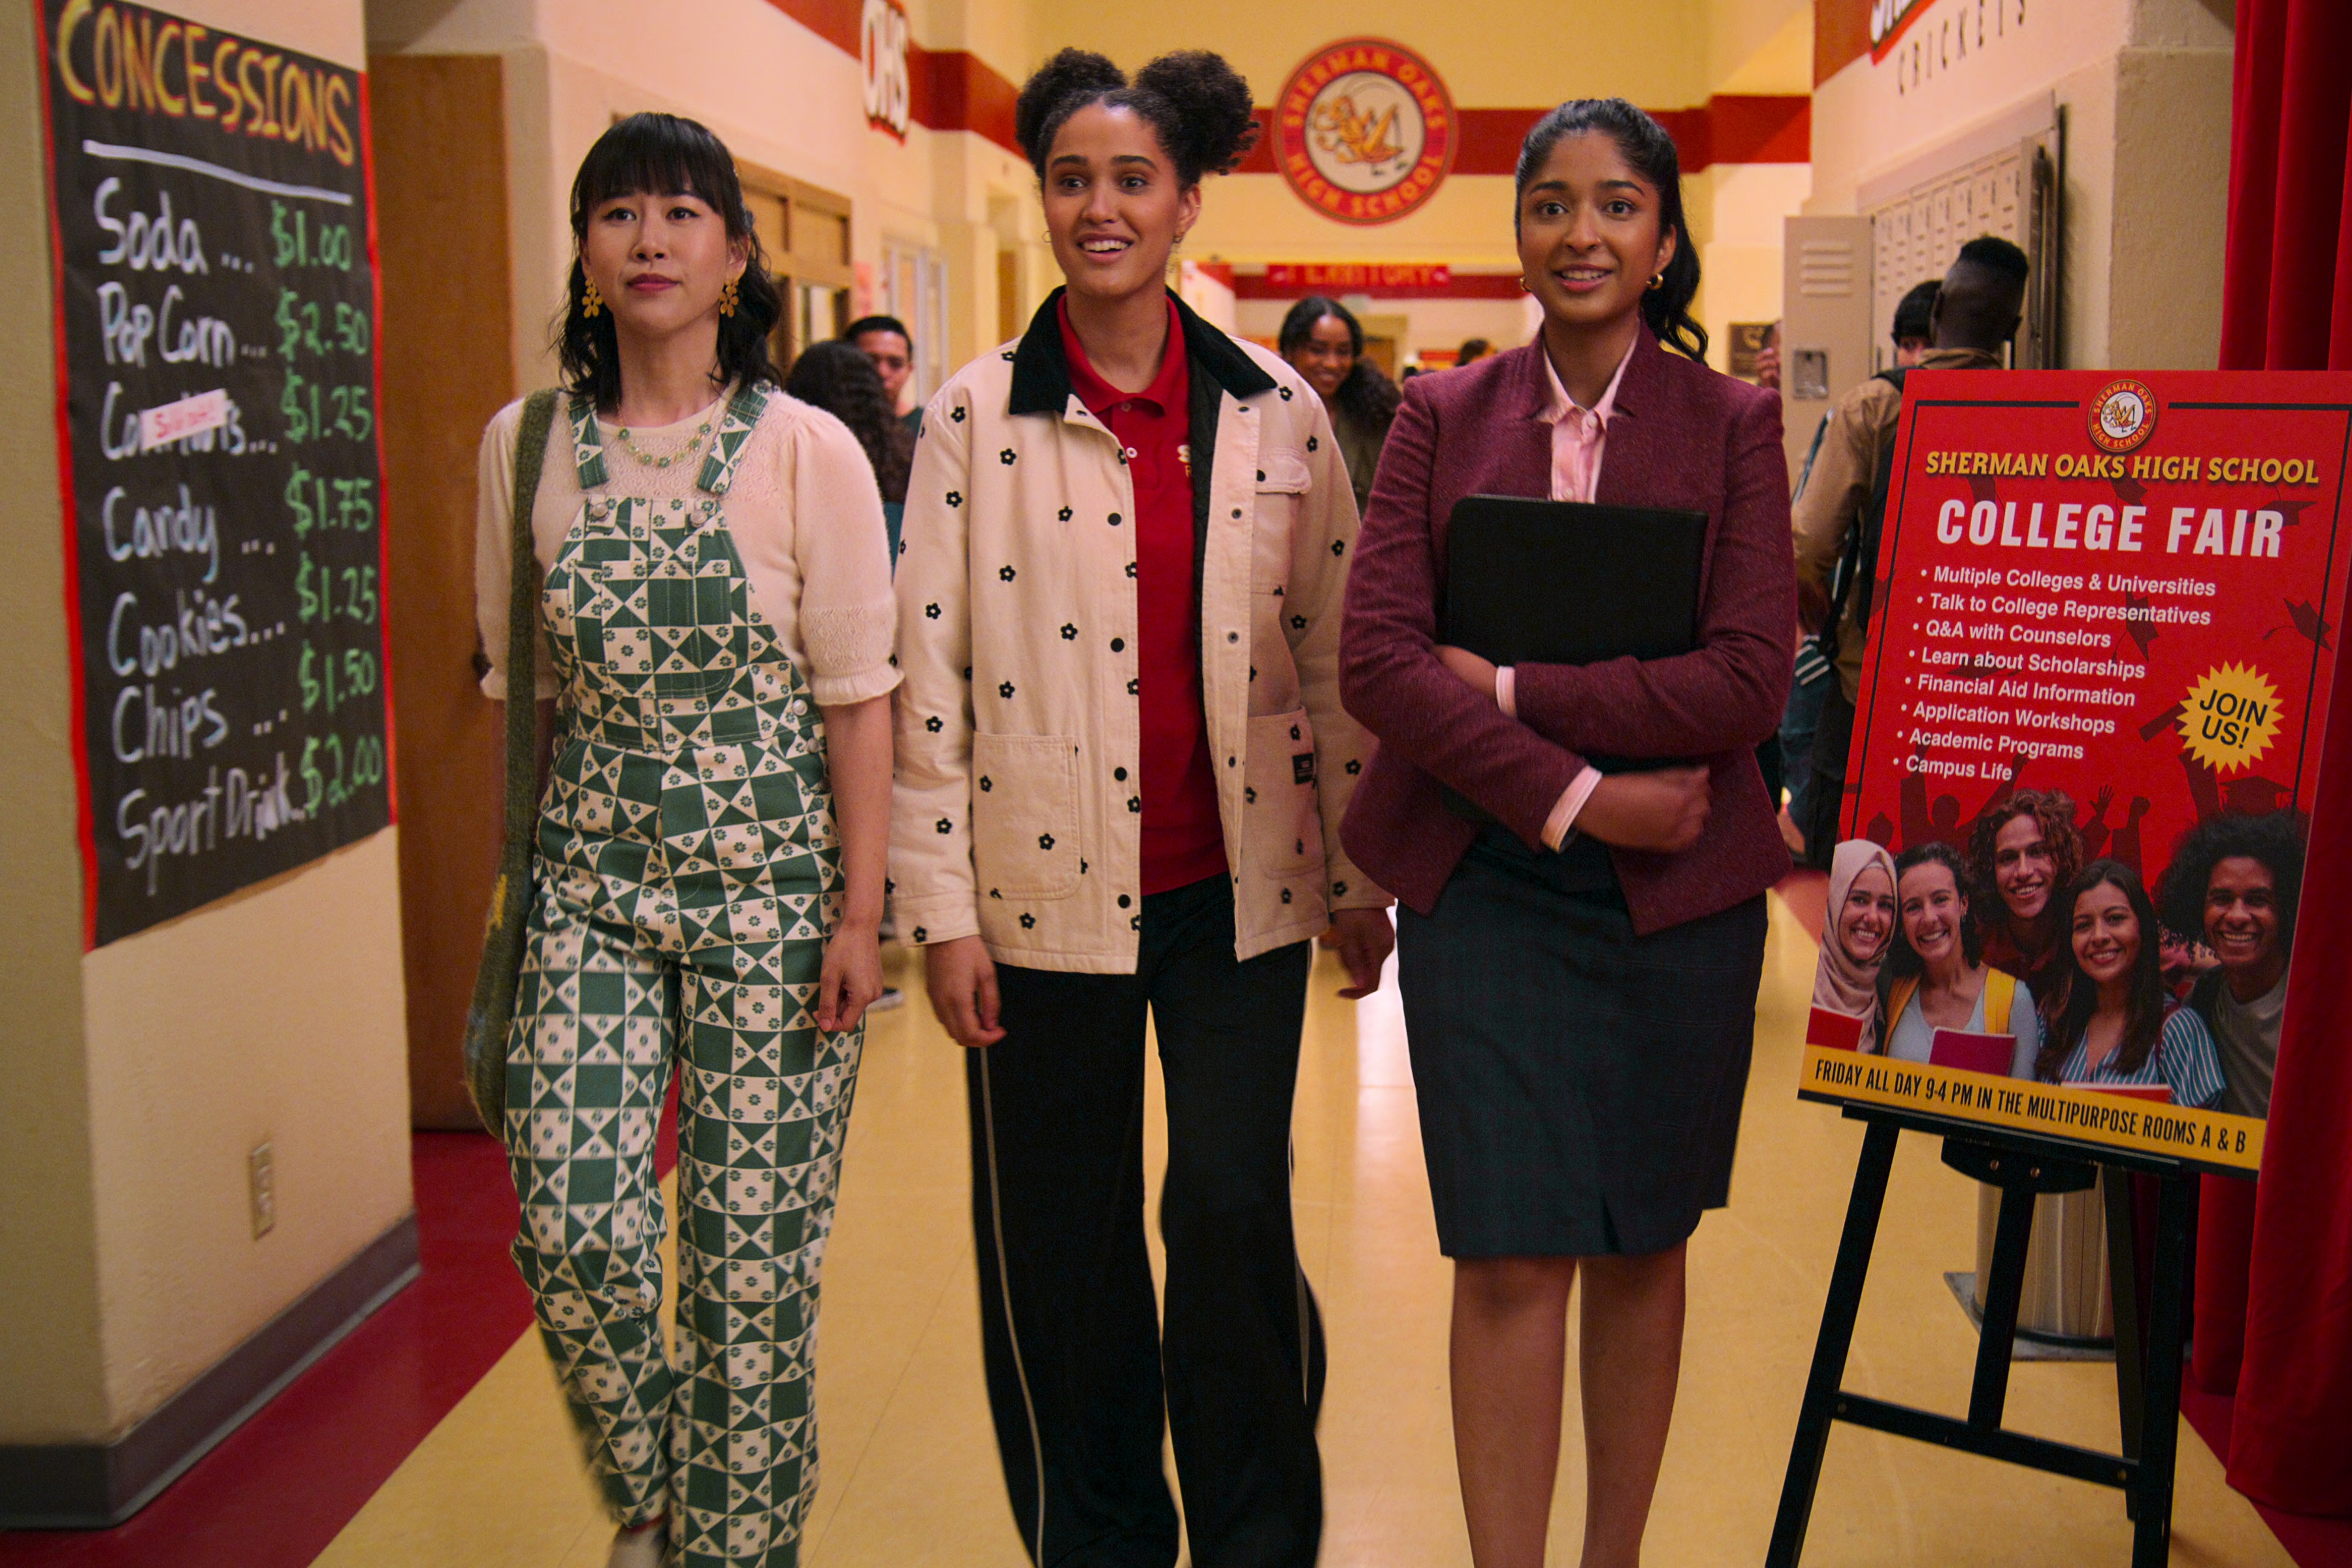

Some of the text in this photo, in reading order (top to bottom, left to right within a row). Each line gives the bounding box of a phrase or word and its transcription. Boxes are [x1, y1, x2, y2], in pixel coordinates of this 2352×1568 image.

[57, 0, 354, 167] CONCESSIONS
[93, 176, 208, 275] Soda
[270, 199, 351, 272] $1.00
[275, 285, 368, 361] $2.50
[281, 367, 372, 443] $1.25
[2094, 383, 2152, 414] SHERMAN OAKS
[2093, 423, 2148, 448] HIGH SCHOOL
[1925, 451, 2319, 483] SHERMAN OAKS HIGH SCHOOL
[102, 483, 220, 583] Candy
[285, 461, 374, 539] $1.75
[1936, 499, 2285, 558] COLLEGE FAIR
[295, 551, 377, 625] $1.25
[1934, 566, 2216, 596] Multiple Colleges & Universities
[1931, 593, 2212, 625] Talk to College Representatives
[1926, 619, 2112, 647] Q&A with Counselors
[1922, 647, 2146, 681] Learn about Scholarships
[112, 683, 229, 763] Chips
[298, 638, 377, 713] $1.50
[1918, 674, 2136, 706] Financial Aid Information
[1913, 701, 2115, 736] Application Workshops
[2199, 689, 2268, 727] JOIN
[1909, 727, 2084, 759] Academic Programs
[2202, 715, 2250, 749] US!
[1906, 755, 2013, 781] Campus Life
[116, 766, 223, 896] Sport
[300, 734, 384, 819] $2.00
[1815, 1058, 2247, 1153] FRIDAY ALL DAY 9-4 PM IN THE MULTIPURPOSE ROOMS A & B
